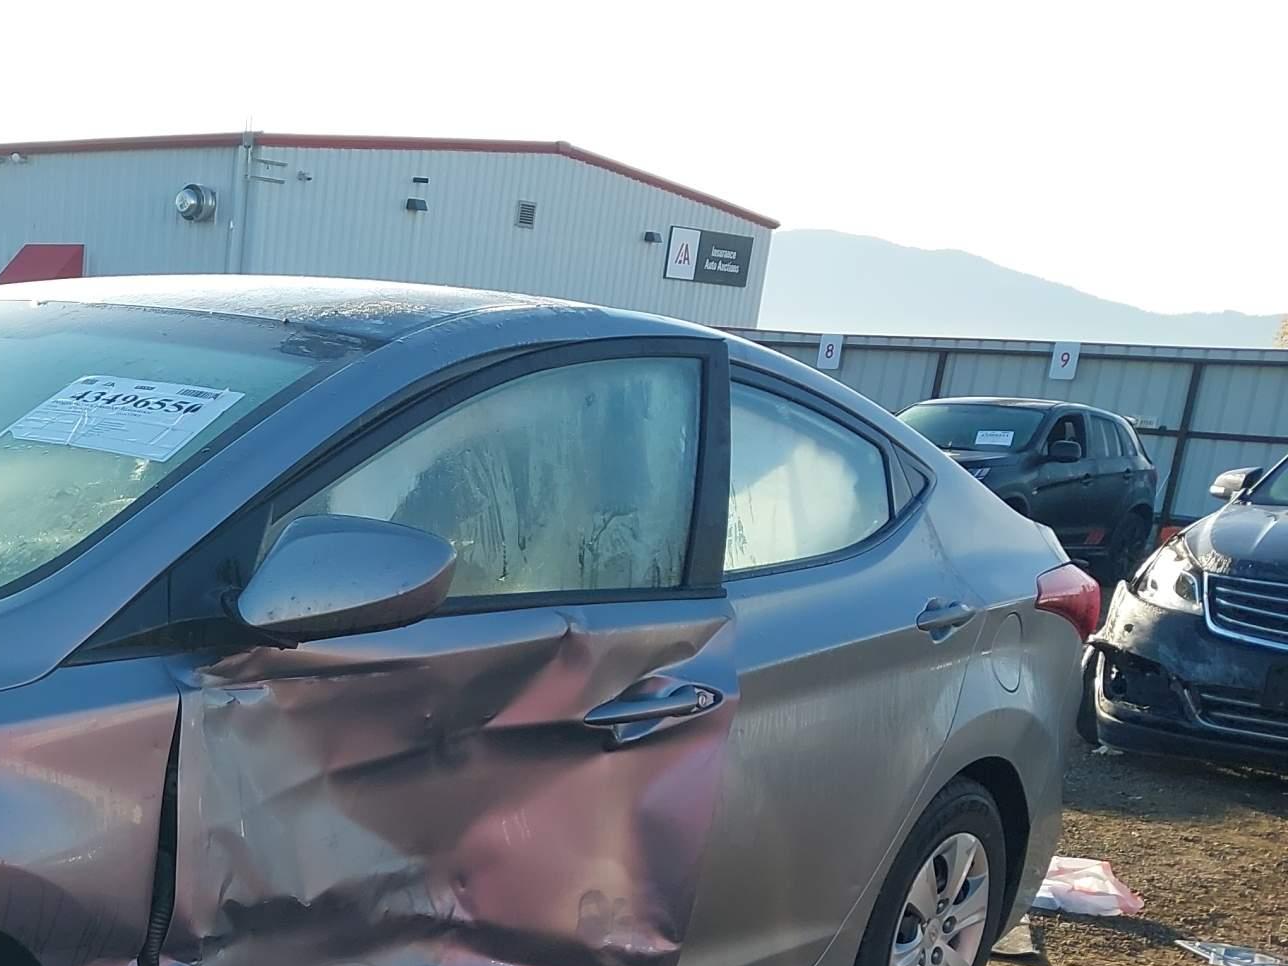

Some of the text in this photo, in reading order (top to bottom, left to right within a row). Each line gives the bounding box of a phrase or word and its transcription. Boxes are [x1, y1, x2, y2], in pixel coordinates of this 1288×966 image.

[704, 258, 717, 271] Auto
[825, 343, 834, 359] 8
[1060, 352, 1070, 368] 9
[70, 389, 205, 415] 43496550
